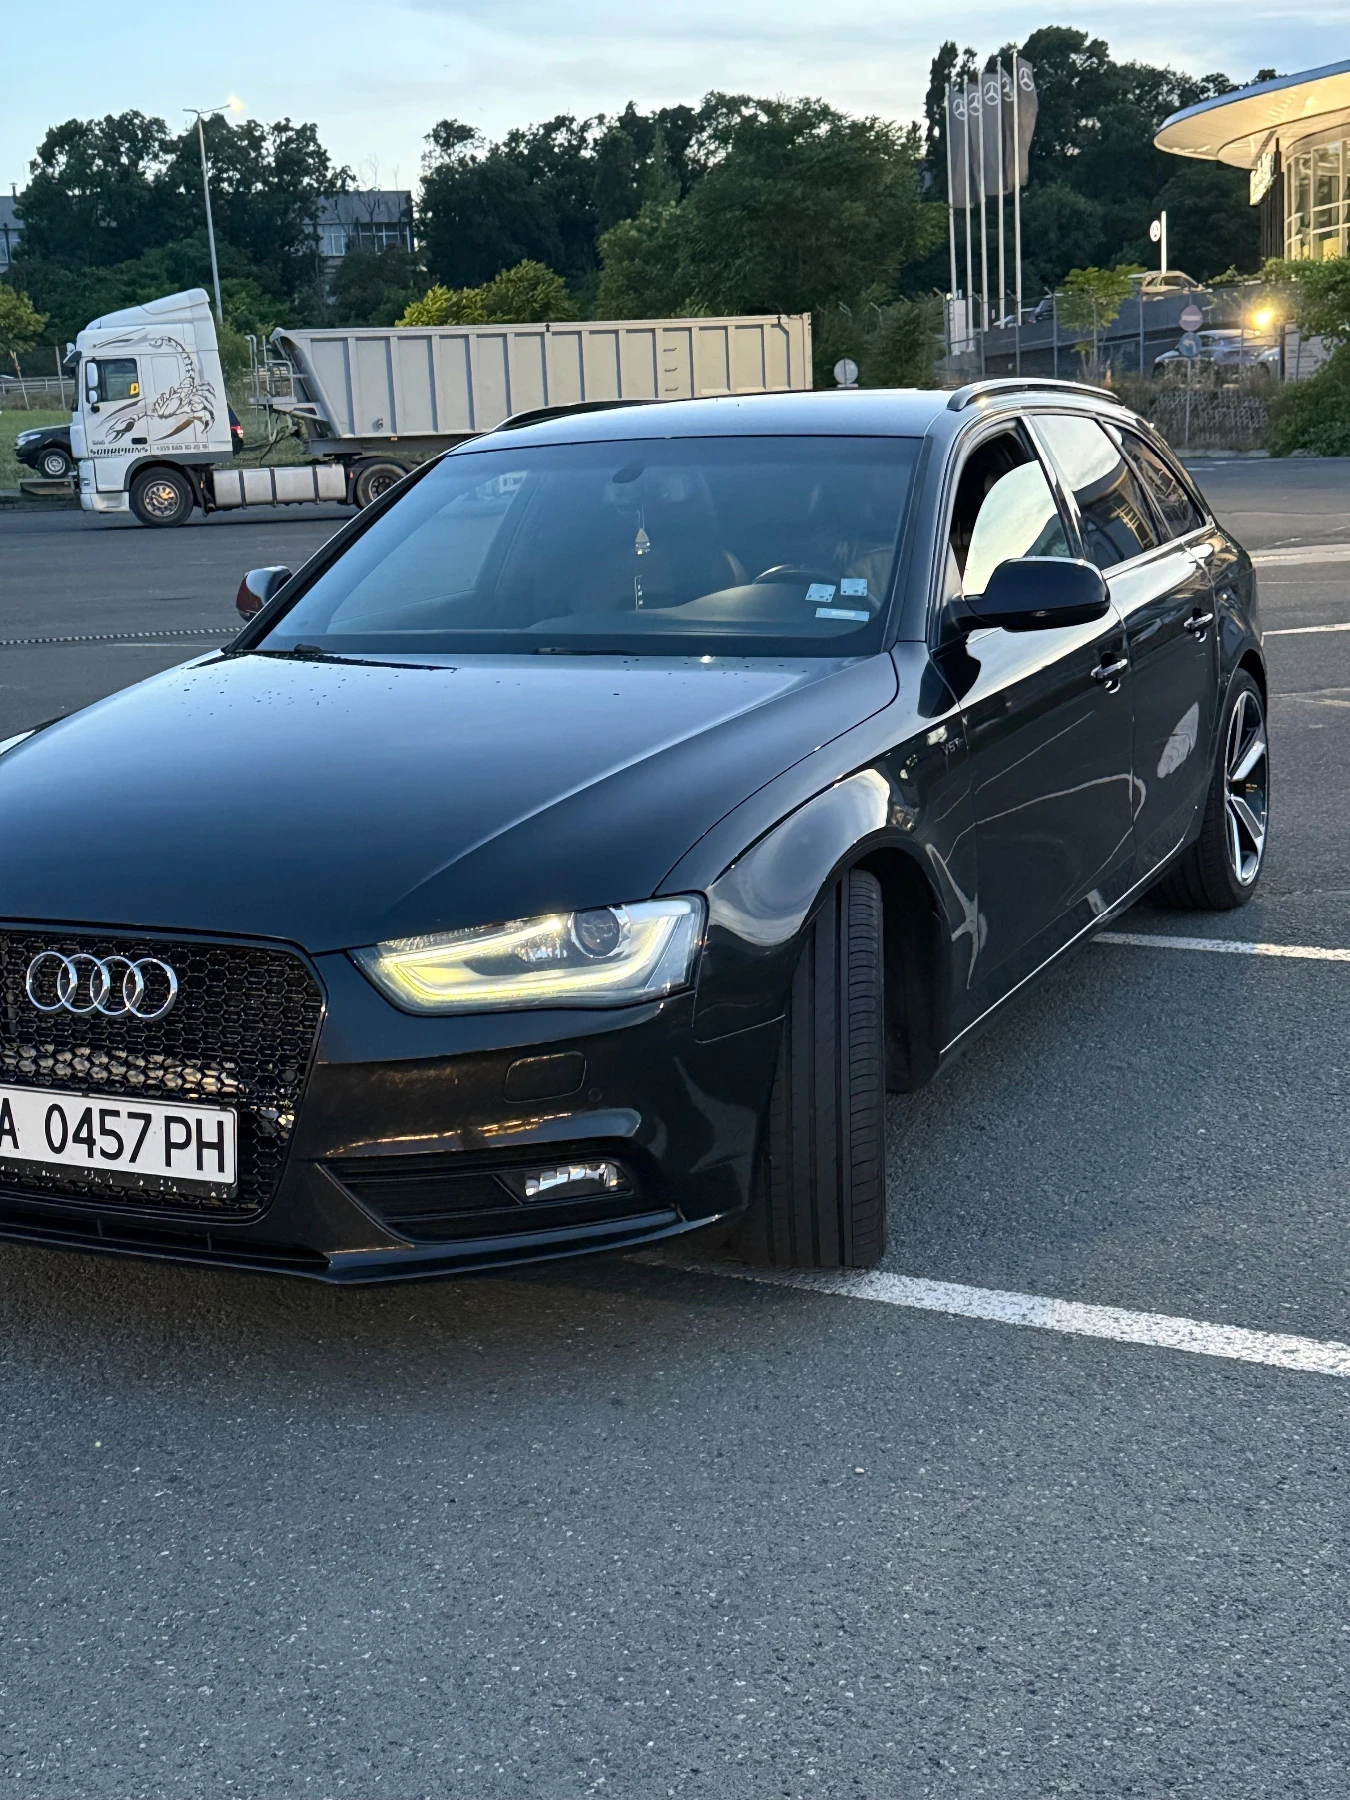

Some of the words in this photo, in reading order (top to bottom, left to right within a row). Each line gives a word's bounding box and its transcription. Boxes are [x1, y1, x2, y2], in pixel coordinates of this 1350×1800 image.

[0, 1097, 20, 1150] A
[44, 1103, 153, 1164] 0457
[164, 1115, 226, 1173] PH
